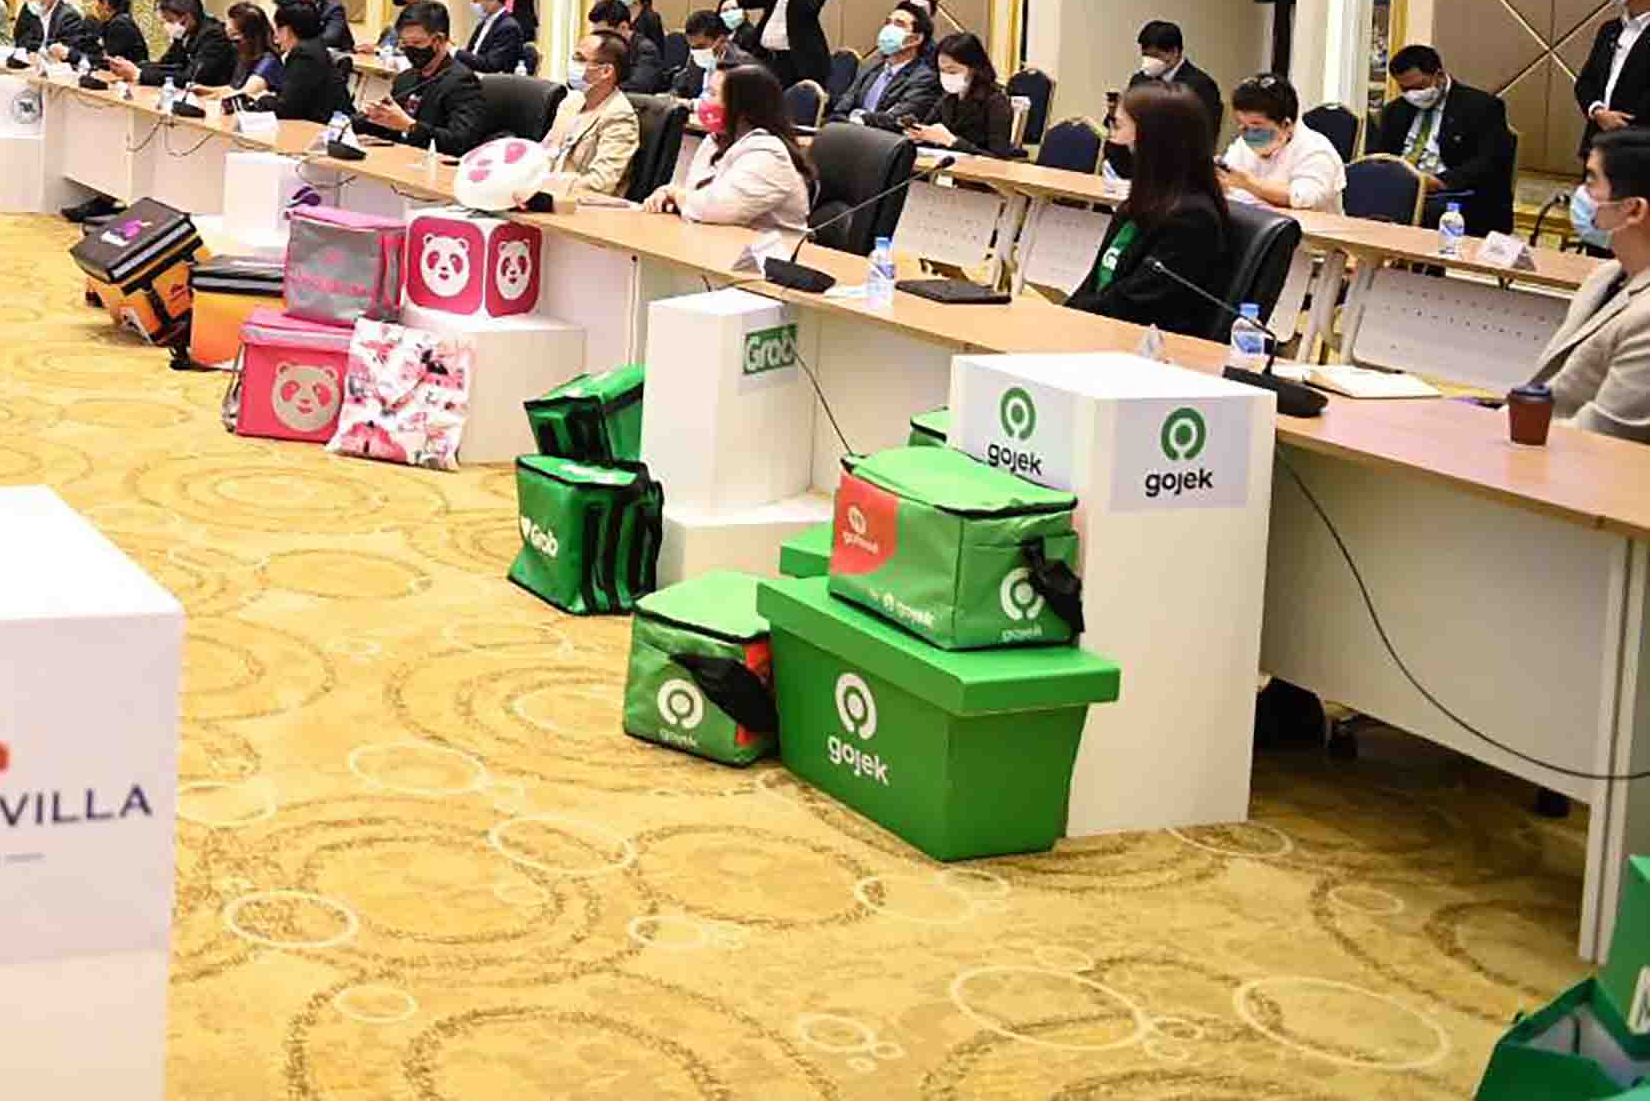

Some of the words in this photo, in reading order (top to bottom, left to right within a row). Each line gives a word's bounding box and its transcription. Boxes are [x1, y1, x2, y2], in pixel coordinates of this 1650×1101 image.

[987, 439, 1042, 477] gojek
[1145, 467, 1213, 498] gojek
[827, 732, 890, 788] gojek
